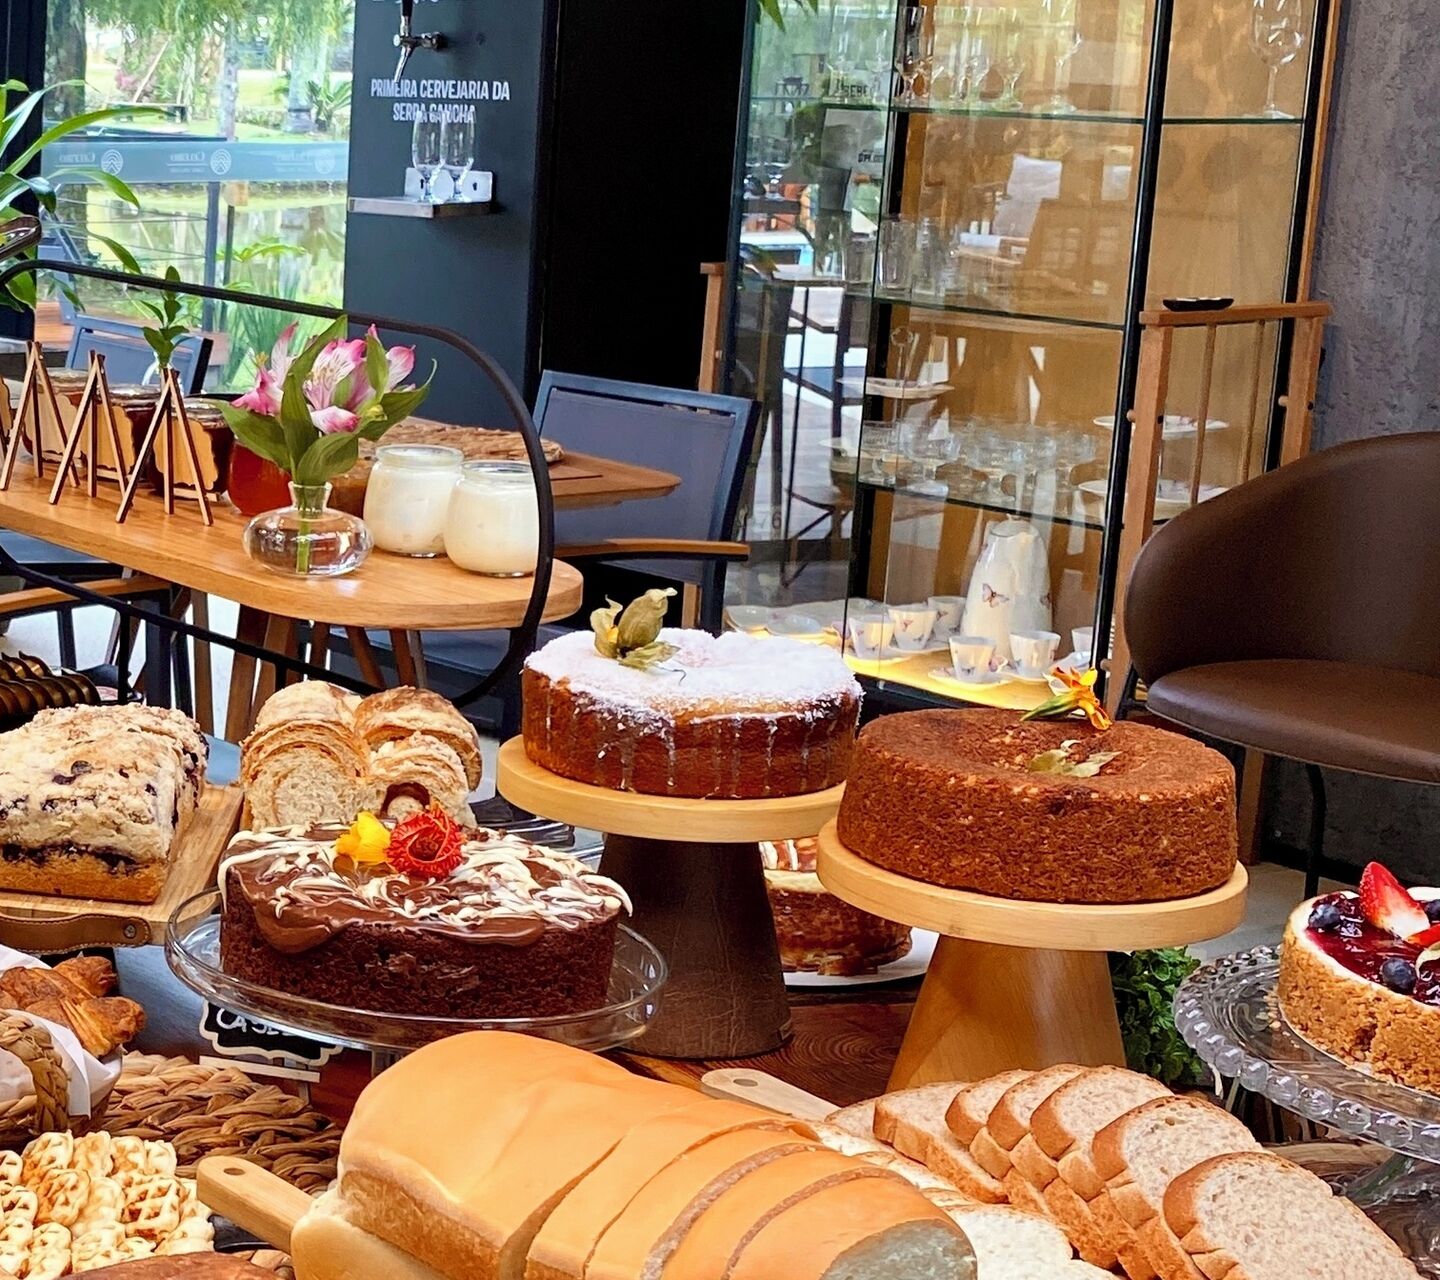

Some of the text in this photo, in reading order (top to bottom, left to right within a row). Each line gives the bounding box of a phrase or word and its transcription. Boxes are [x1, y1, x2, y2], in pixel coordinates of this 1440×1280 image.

[371, 78, 510, 100] PRIMEIRA CERVEJARIA DA
